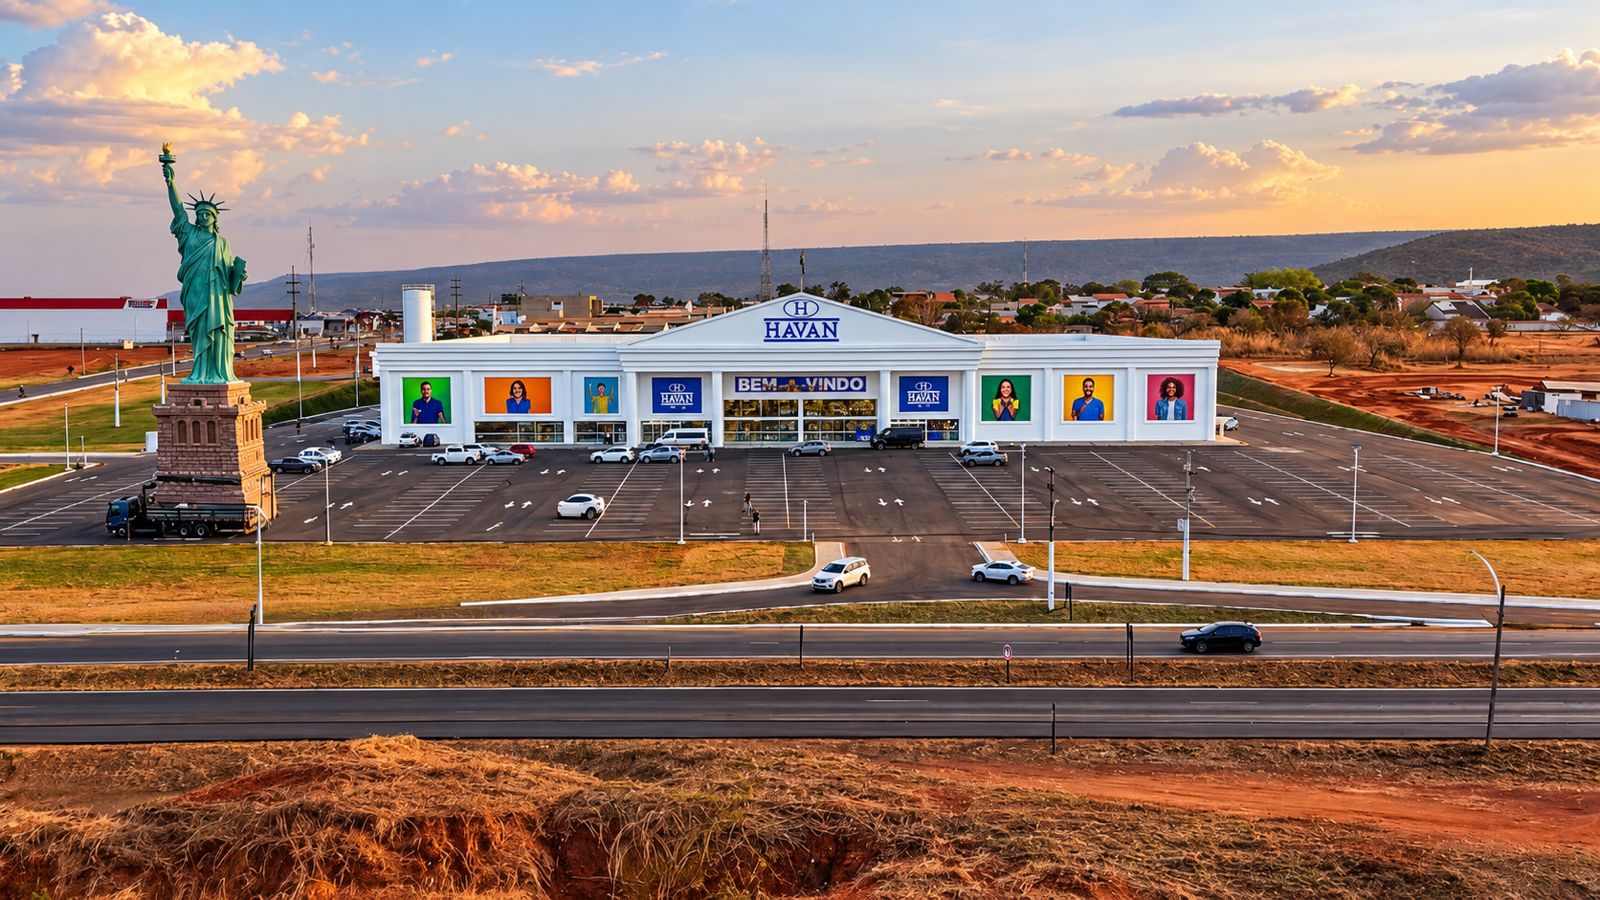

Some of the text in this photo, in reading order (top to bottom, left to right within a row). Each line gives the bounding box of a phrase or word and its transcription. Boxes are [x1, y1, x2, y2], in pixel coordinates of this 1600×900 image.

[794, 302, 808, 315] H
[765, 322, 838, 338] HAVAN
[738, 378, 777, 391] BEM
[661, 394, 693, 404] HAVAN
[908, 392, 940, 402] HAVAN
